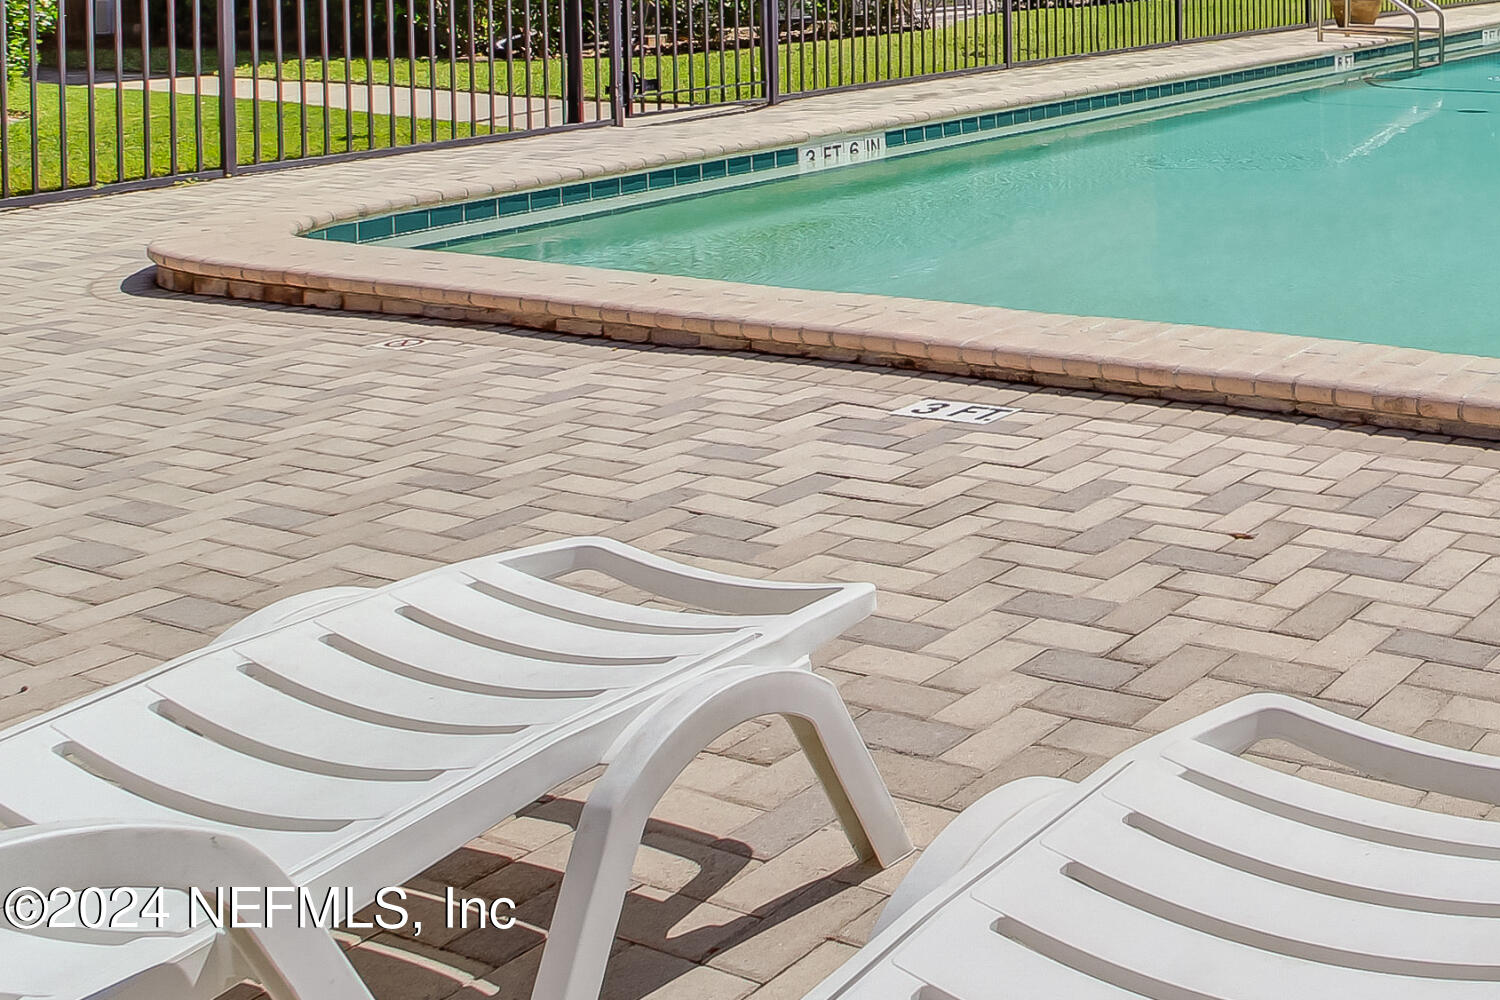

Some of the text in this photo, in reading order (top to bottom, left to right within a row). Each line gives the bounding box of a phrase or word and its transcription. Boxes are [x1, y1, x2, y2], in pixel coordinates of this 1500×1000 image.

[823, 144, 842, 159] FT
[849, 141, 859, 155] 6
[866, 137, 881, 152] IN
[910, 402, 951, 415] 3
